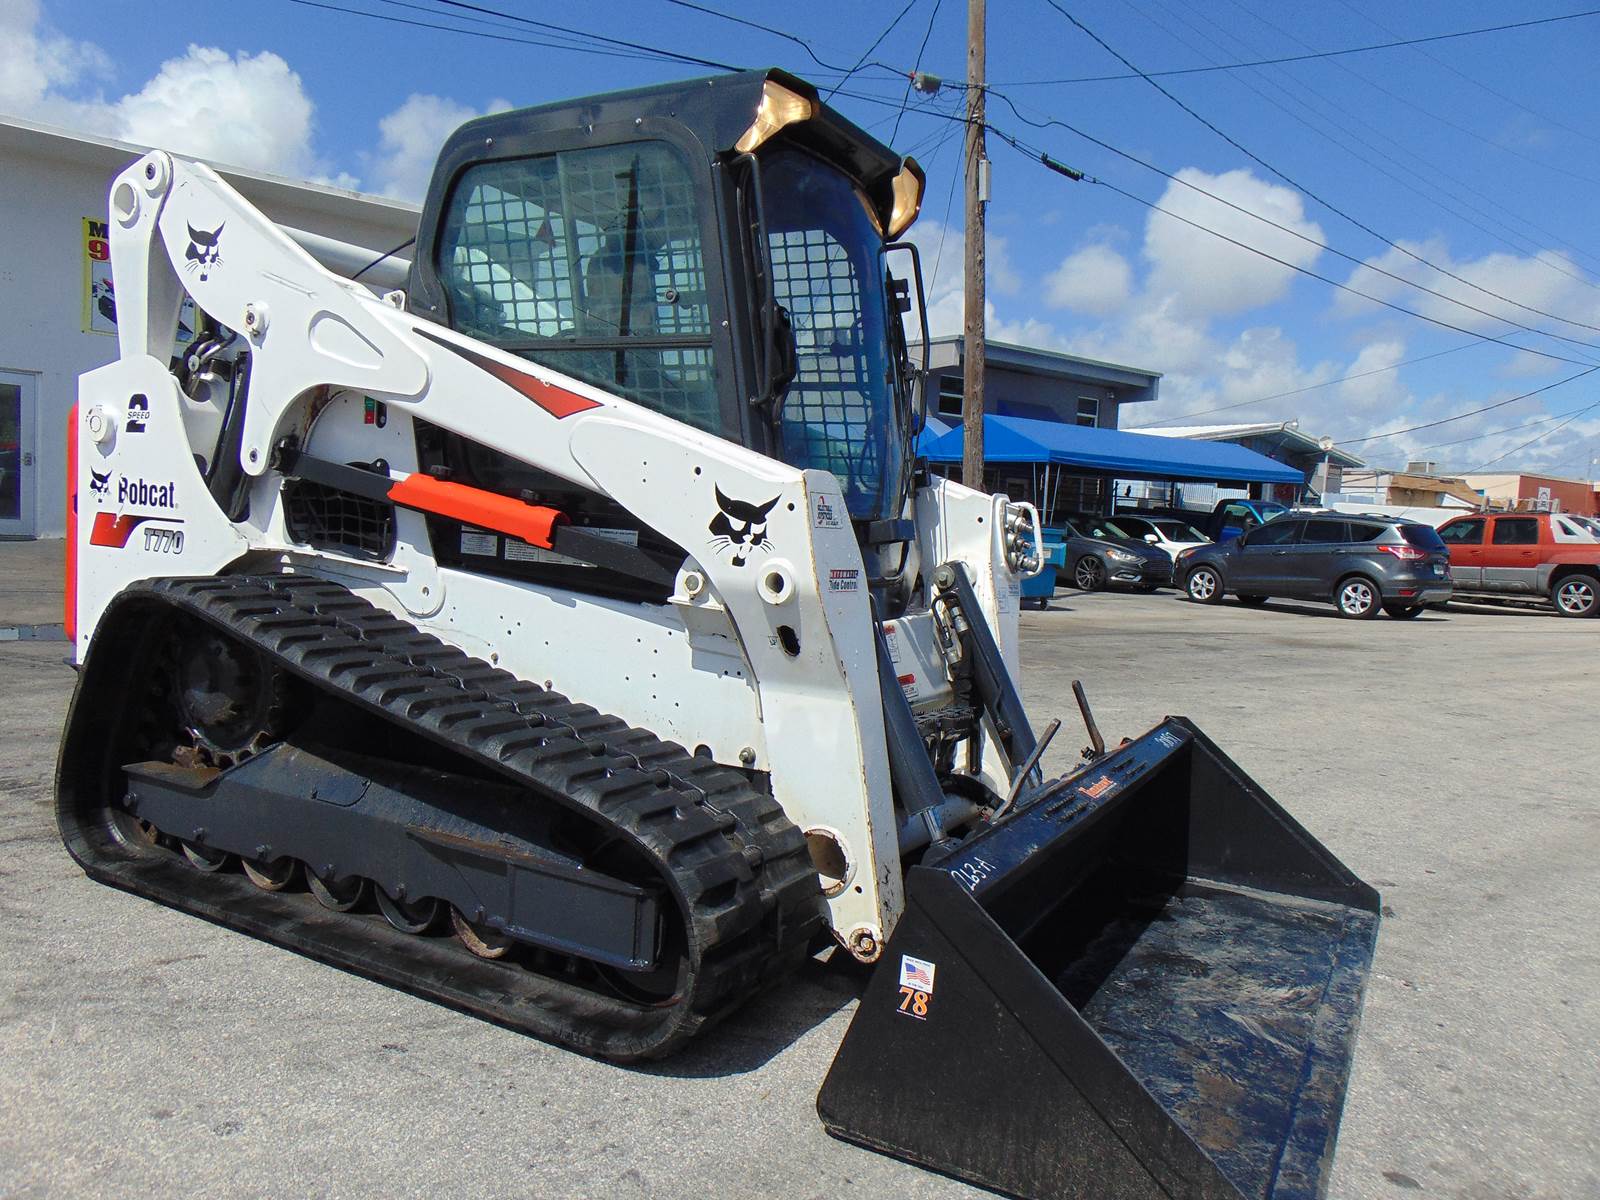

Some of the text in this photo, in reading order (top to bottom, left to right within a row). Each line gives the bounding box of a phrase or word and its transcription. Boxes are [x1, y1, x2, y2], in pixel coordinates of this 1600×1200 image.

[127, 411, 151, 420] SPEED
[118, 476, 175, 509] Bobcat
[144, 527, 185, 555] T770
